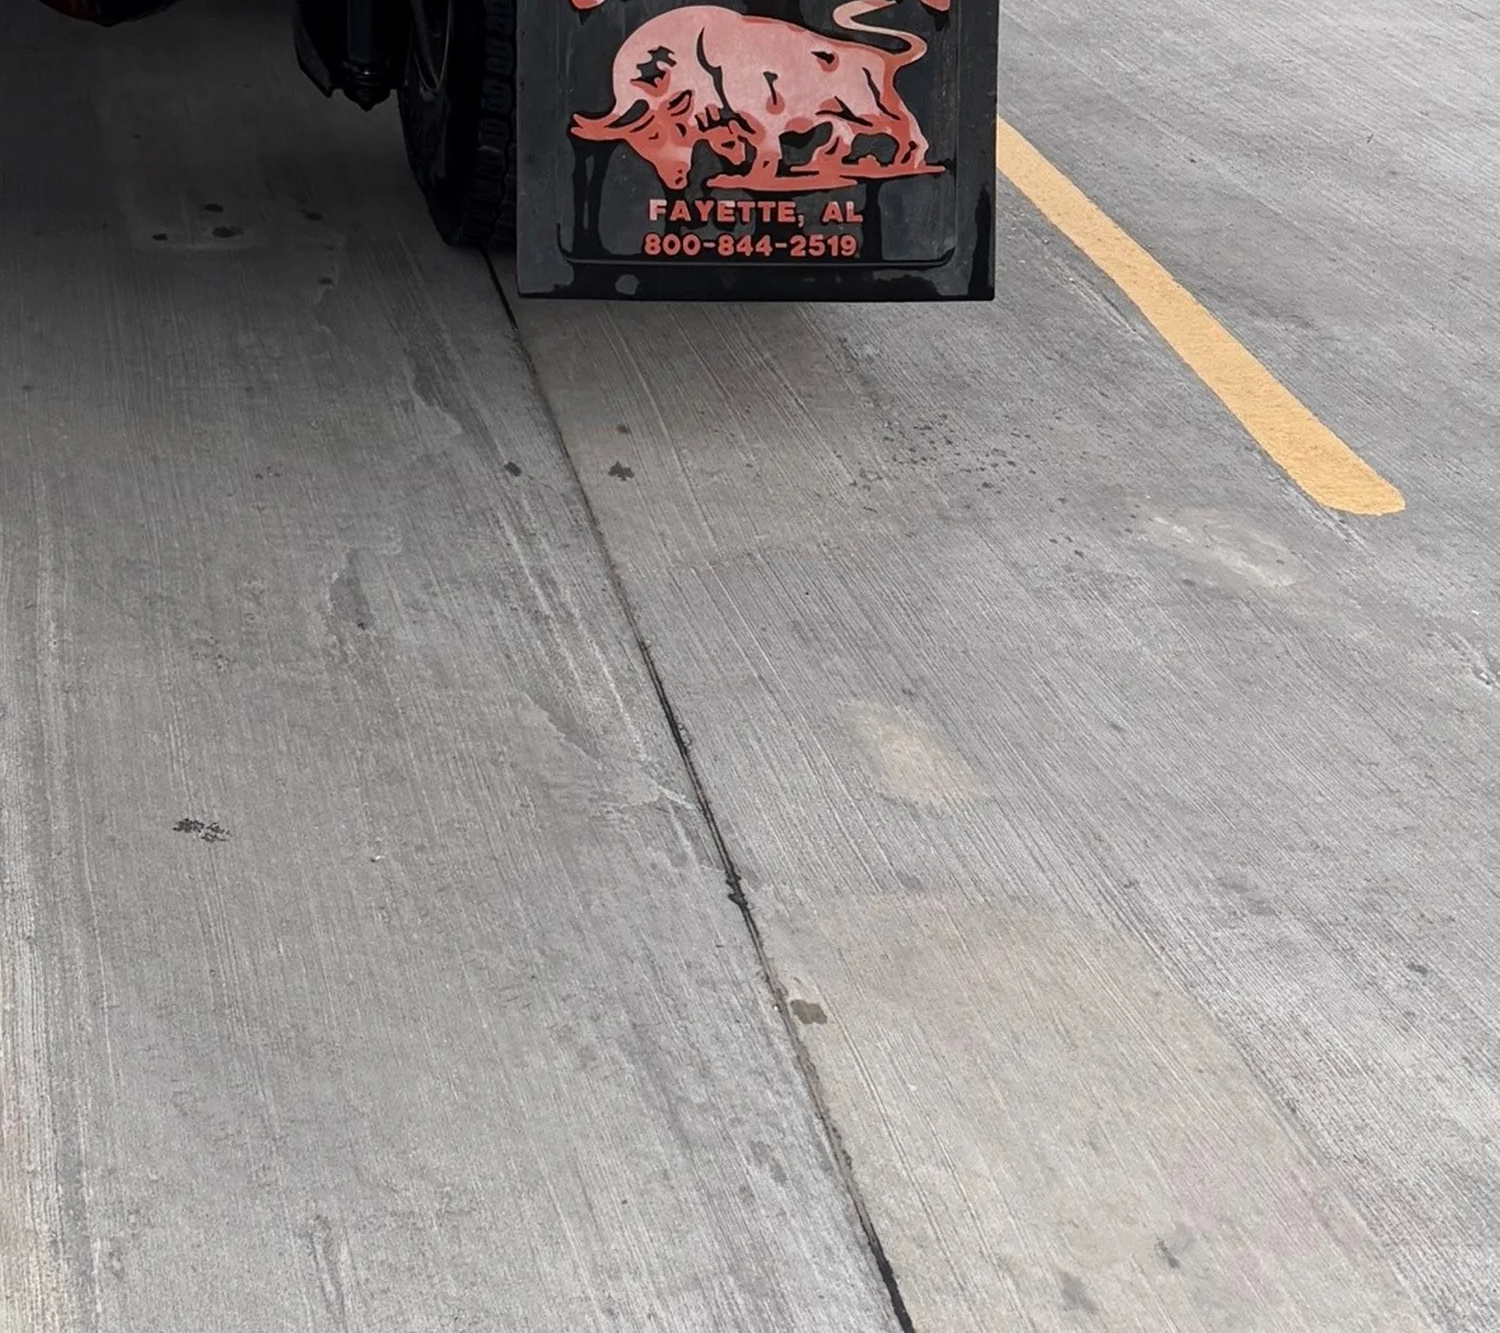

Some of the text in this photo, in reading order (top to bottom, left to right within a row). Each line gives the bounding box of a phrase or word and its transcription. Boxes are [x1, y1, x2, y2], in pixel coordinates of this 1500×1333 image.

[648, 199, 864, 227] FAYETTE, AL
[644, 234, 858, 257] 800-844-2519
